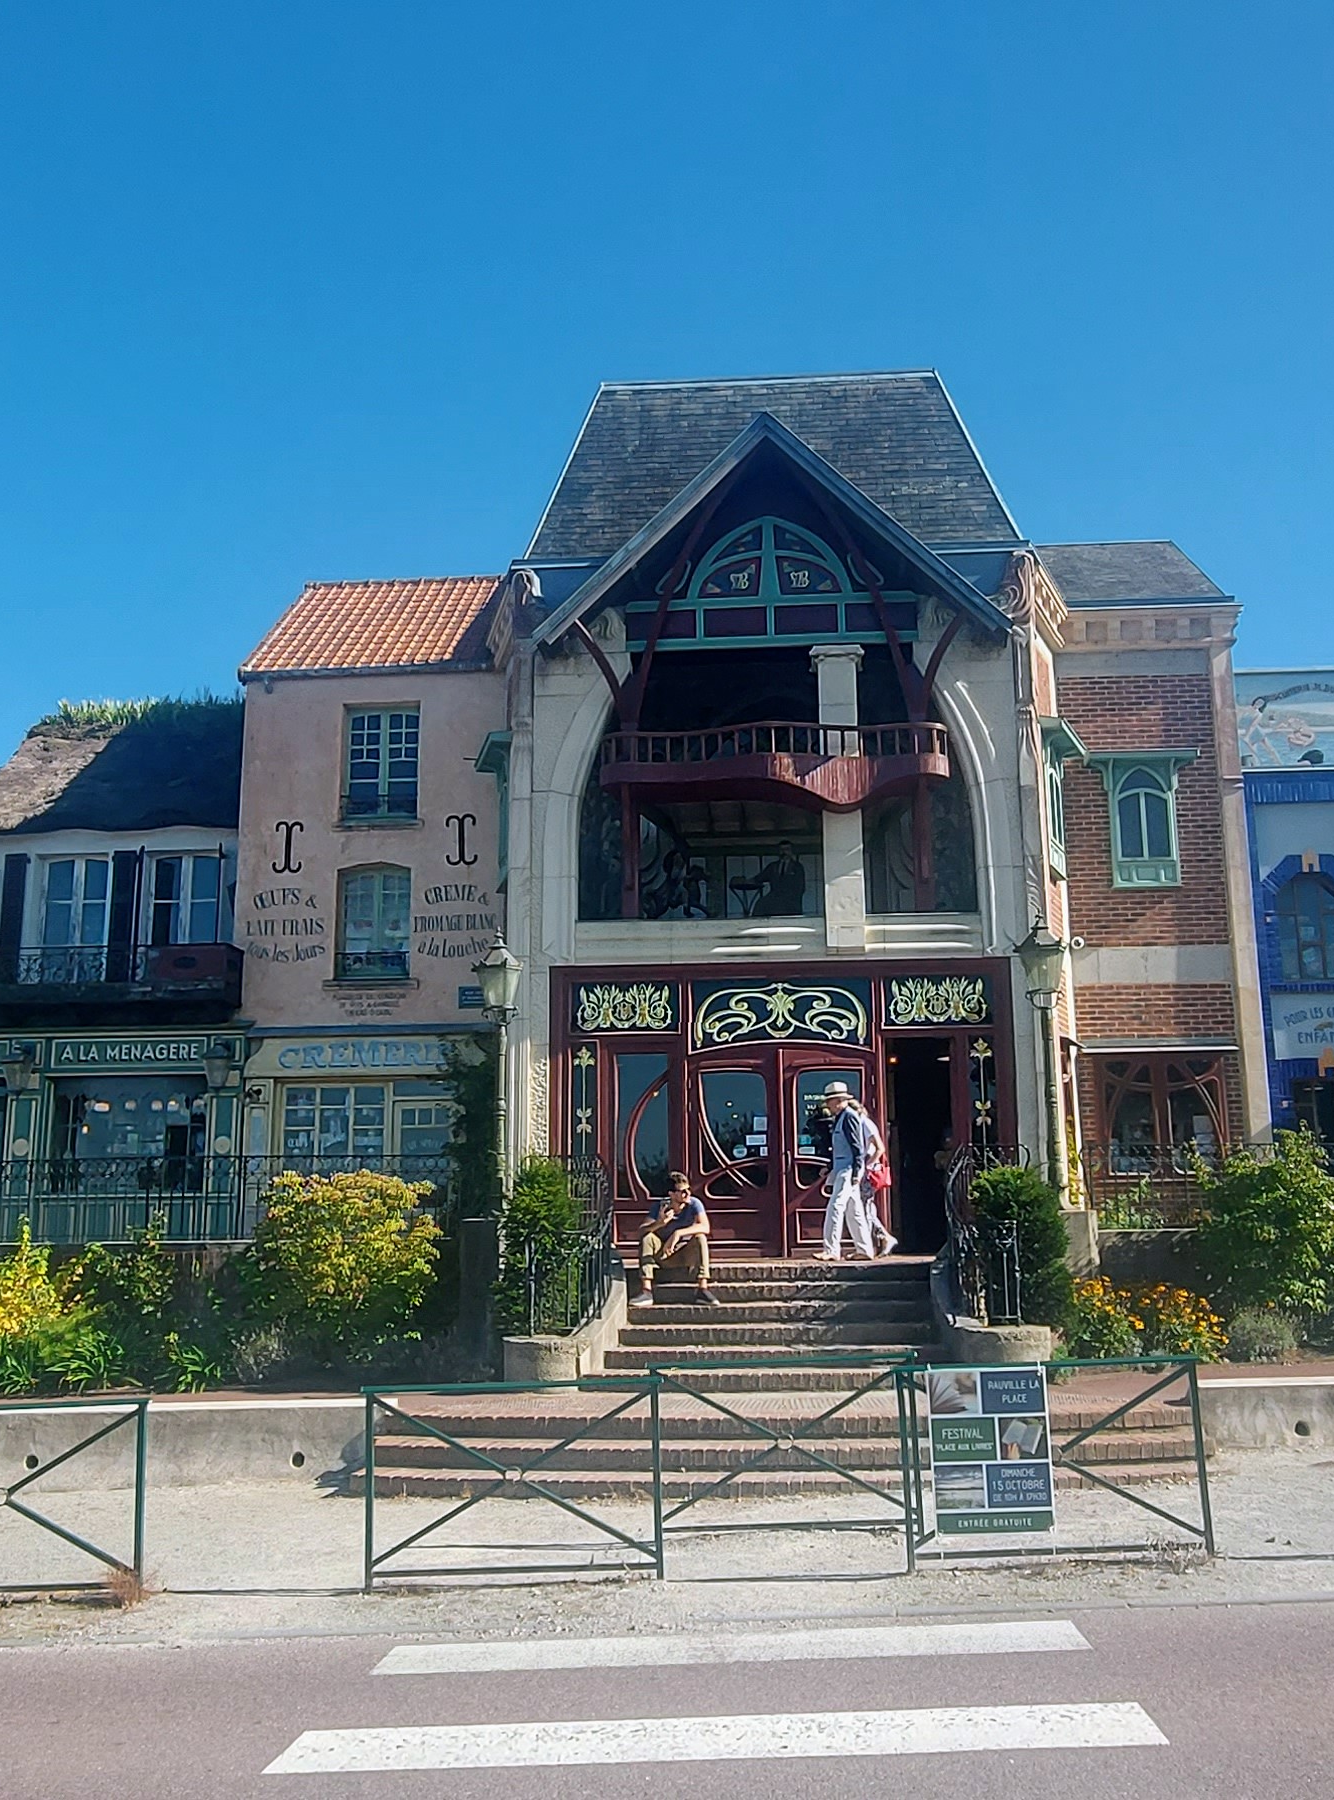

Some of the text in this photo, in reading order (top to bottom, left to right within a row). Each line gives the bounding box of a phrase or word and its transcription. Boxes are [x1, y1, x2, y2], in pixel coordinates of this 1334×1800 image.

[305, 894, 318, 909] &
[477, 892, 490, 906] &
[247, 917, 325, 937] LAIT FRAIS
[413, 913, 497, 933] FROMAGE BLANC
[272, 943, 290, 963] les
[427, 937, 439, 957] la
[442, 936, 489, 958] Louche
[1283, 1010, 1308, 1027] POUR
[1309, 1007, 1324, 1019] LES
[61, 1043, 199, 1061] A LA MENAGERE
[987, 1379, 1040, 1390] RAUVILLE LA
[1002, 1394, 1027, 1404] PLACE
[941, 1428, 984, 1440] FESTIVAL
[1001, 1467, 1036, 1478] DIMANCHE
[992, 1479, 1045, 1491] 15 OCTOBRE
[993, 1517, 1033, 1528] GRATUITE
